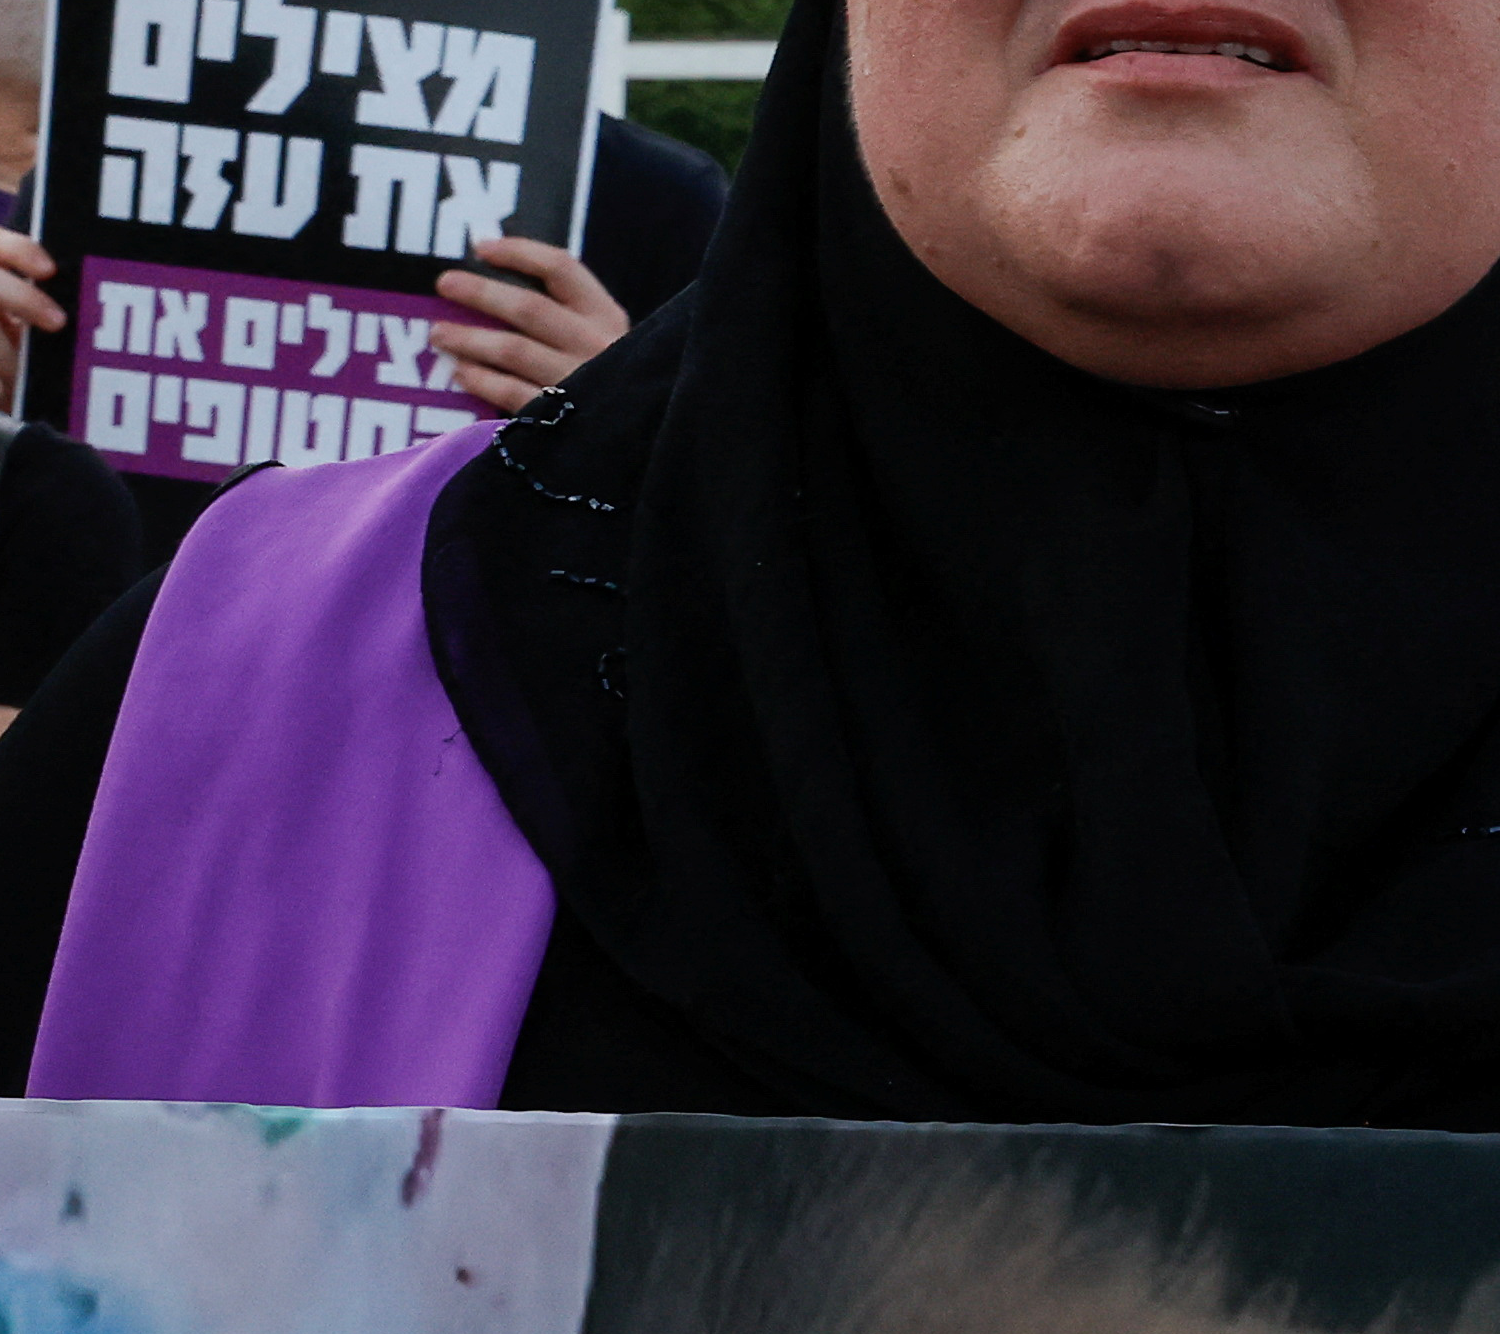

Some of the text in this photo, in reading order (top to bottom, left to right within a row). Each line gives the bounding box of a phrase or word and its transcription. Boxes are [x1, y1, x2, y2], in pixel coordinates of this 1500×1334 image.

[98, 113, 522, 261] את עזה
[92, 280, 209, 363] את
